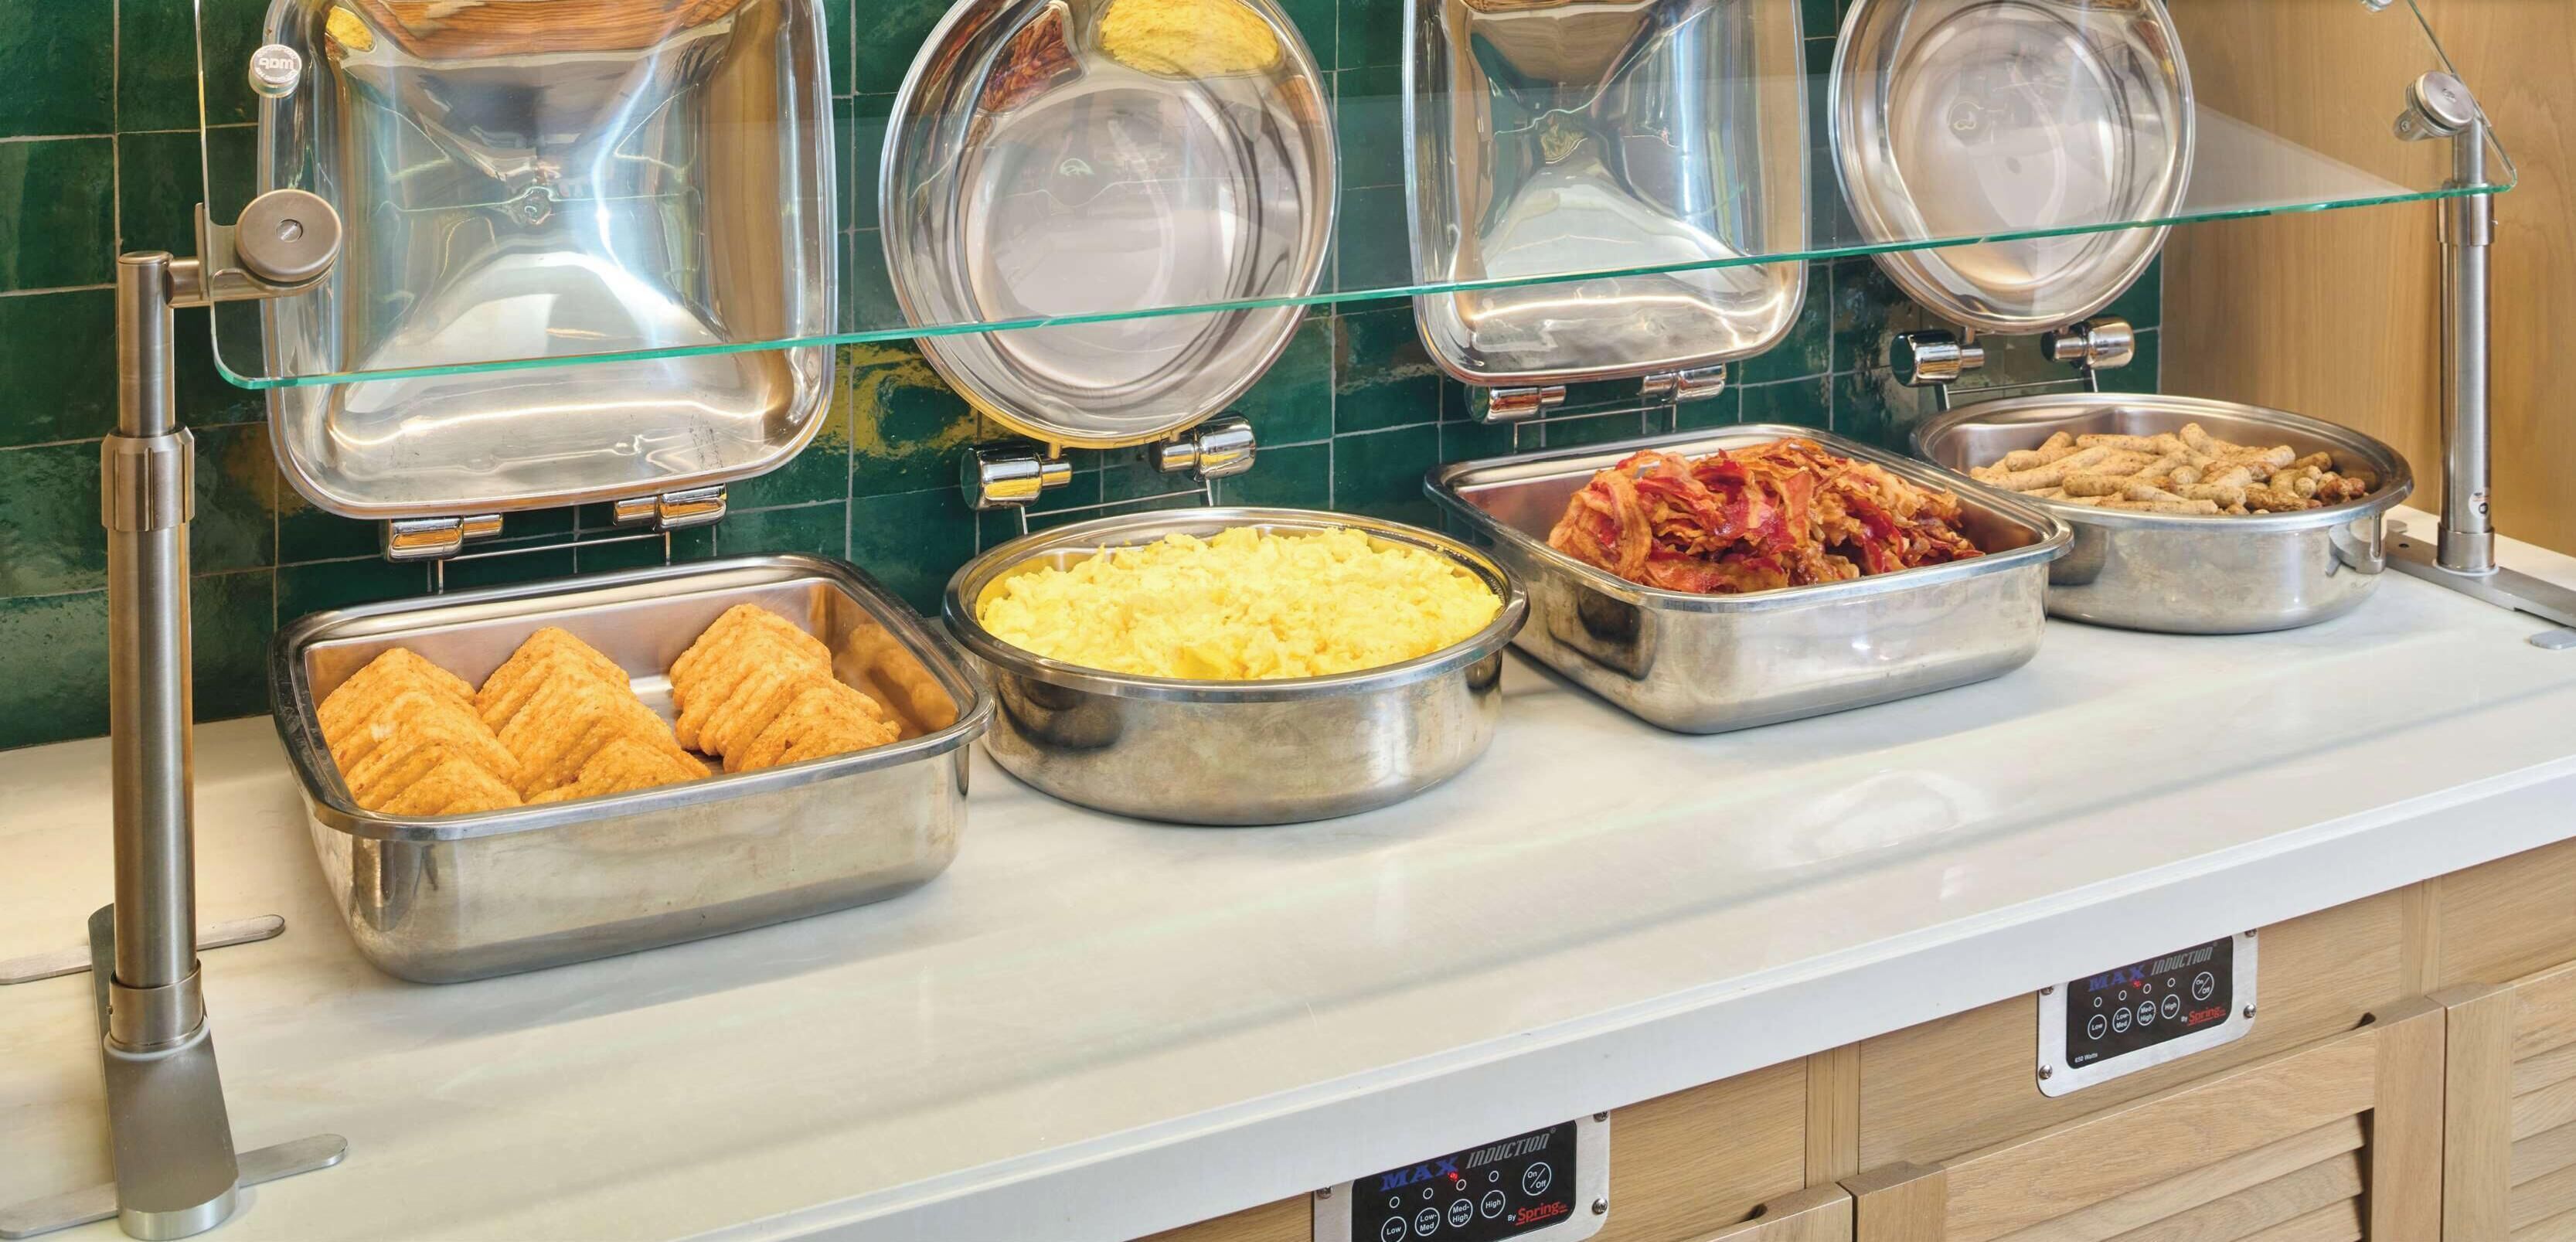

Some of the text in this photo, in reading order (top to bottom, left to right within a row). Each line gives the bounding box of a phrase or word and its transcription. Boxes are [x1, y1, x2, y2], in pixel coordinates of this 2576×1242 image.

[2088, 947, 2213, 992] MAX INDUCTION
[2165, 1002, 2177, 1011] High
[2140, 1014, 2152, 1023] High
[2188, 1006, 2221, 1024] Spring
[1380, 1132, 1550, 1191] MAX INDUCTION
[1452, 1203, 1470, 1213] Med-
[1485, 1199, 1501, 1210] High
[1517, 1201, 1560, 1223] Spring
[1420, 1213, 1438, 1223] Low-
[1452, 1213, 1468, 1223] High
[1387, 1226, 1401, 1236] Low
[1420, 1222, 1434, 1232] Med
